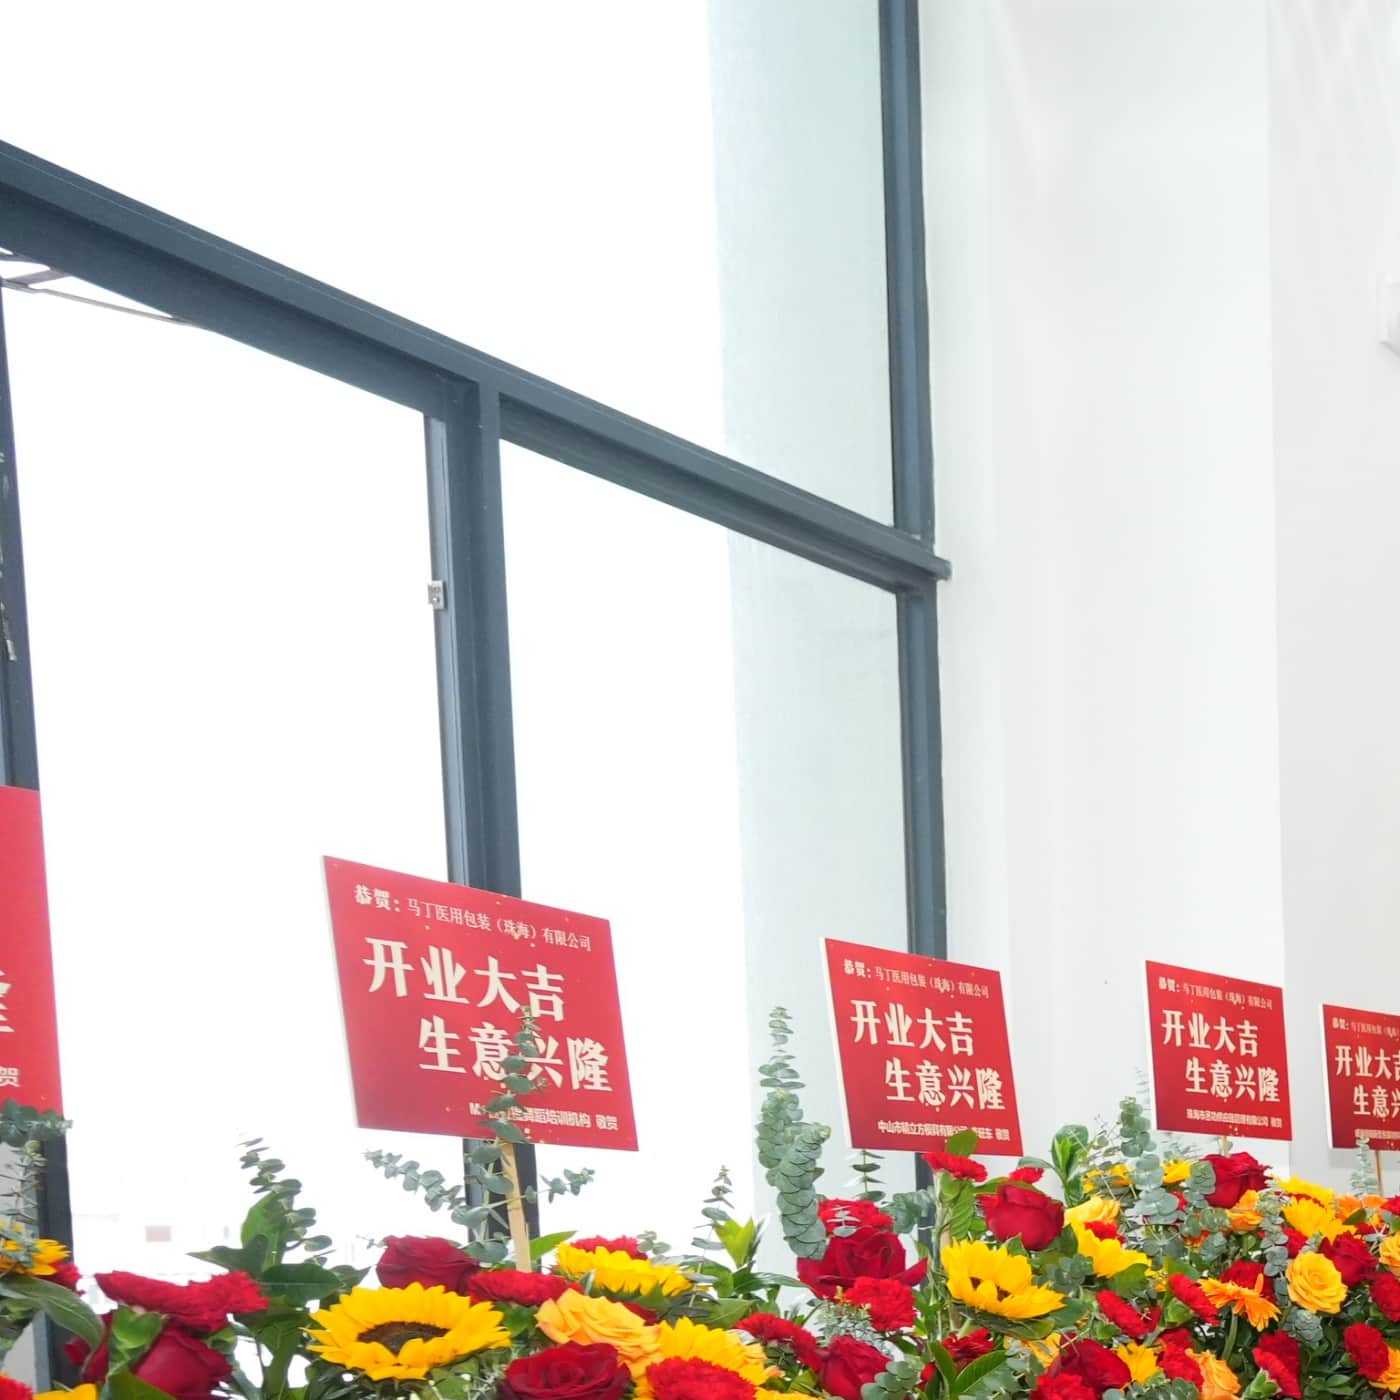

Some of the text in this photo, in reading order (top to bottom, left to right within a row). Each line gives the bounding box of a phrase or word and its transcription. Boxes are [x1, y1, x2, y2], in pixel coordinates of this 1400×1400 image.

[362, 936, 565, 1022] 开业大吉
[418, 1015, 613, 1092] 生意兴隆
[851, 999, 975, 1057] 开业大吉
[1161, 1009, 1259, 1058] 开业大吉
[885, 1057, 1006, 1111] 生意兴隆
[1185, 1056, 1281, 1103] 生意兴隆
